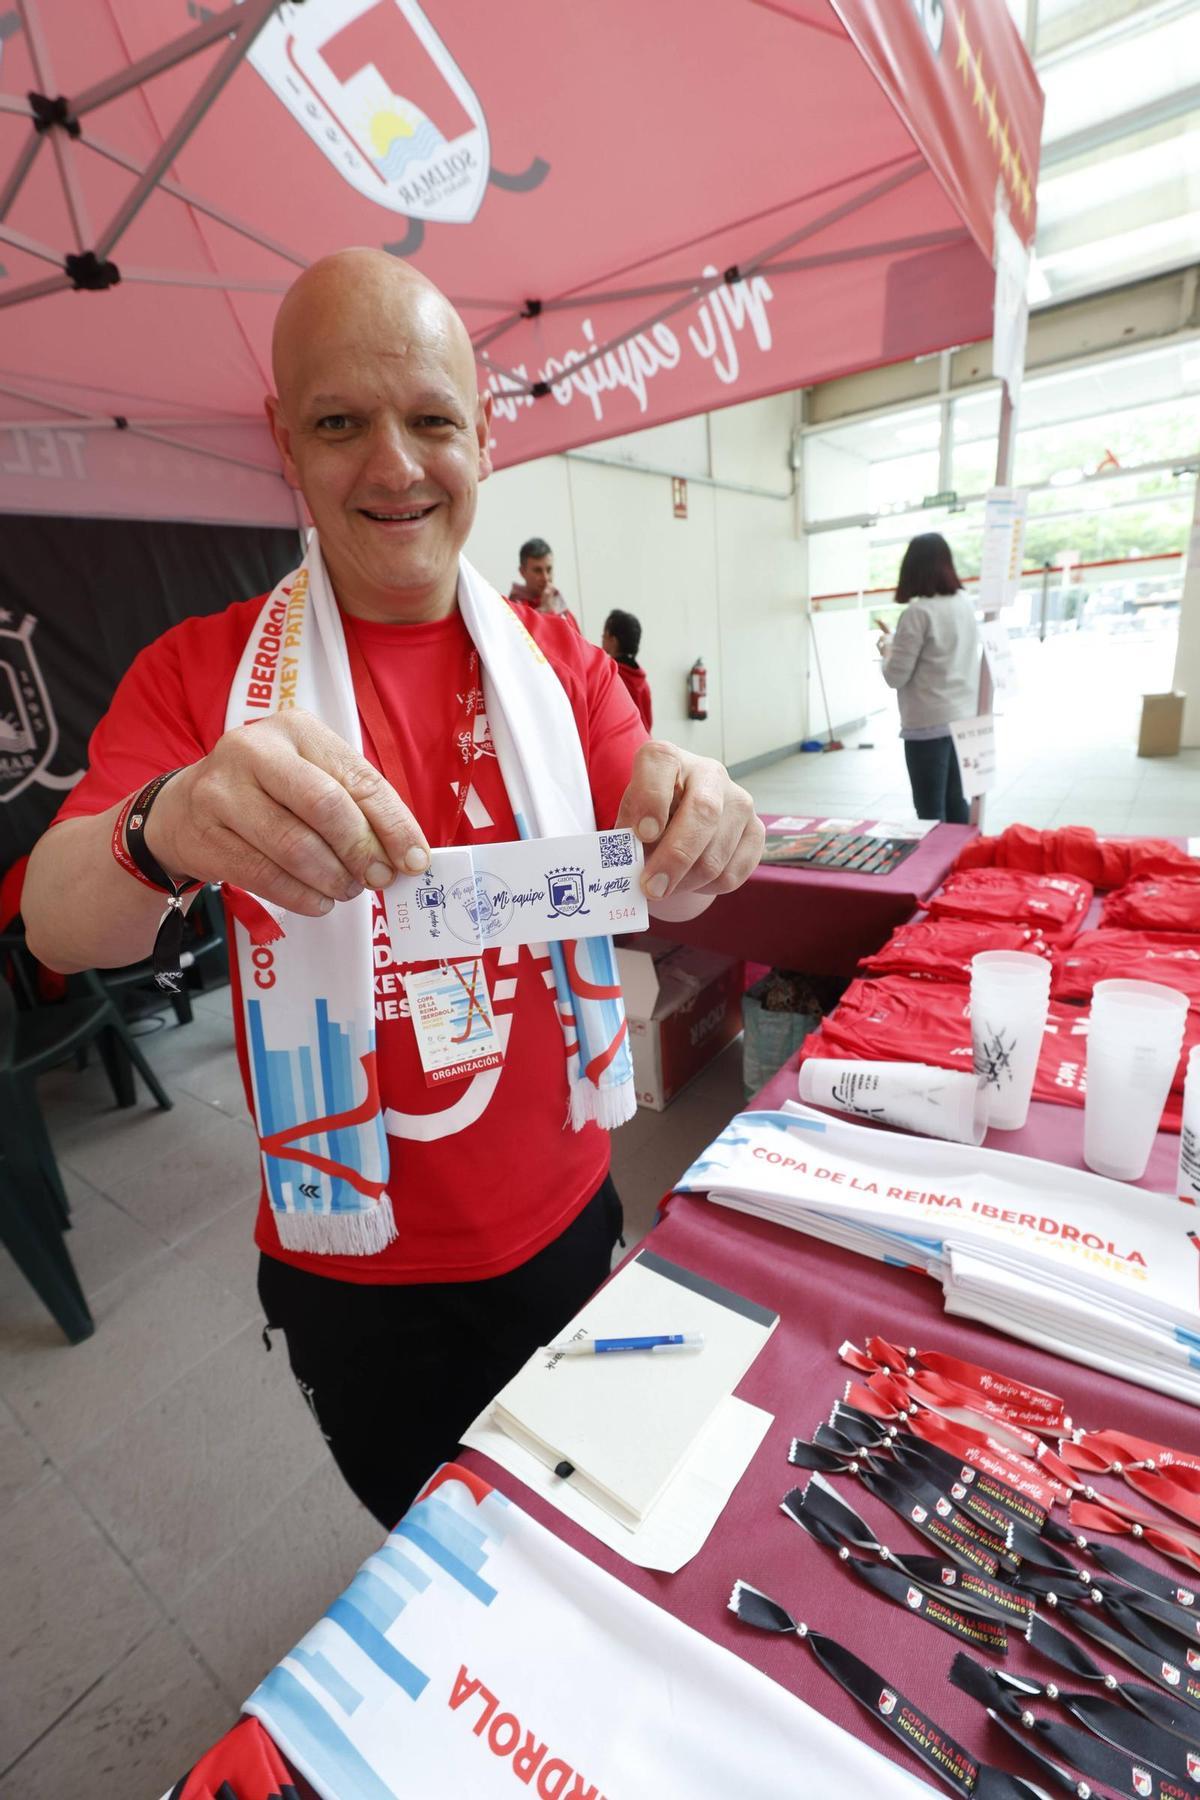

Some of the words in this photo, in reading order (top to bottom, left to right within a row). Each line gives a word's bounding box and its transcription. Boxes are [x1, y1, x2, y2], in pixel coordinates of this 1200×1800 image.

[493, 890, 509, 909] Mi
[511, 888, 545, 909] equipo
[588, 878, 602, 893] mi
[601, 876, 633, 897] gente
[396, 901, 411, 931] 1501
[608, 907, 637, 922] 1544
[432, 1055, 500, 1081] ORGANIZACIÓN
[752, 1147, 807, 1173] COPA
[814, 1167, 846, 1184] DE
[850, 1178, 878, 1193] LA
[886, 1187, 963, 1208] REINA
[971, 1202, 1147, 1267] IBERDROLA
[545, 1328, 588, 1370] Libank
[979, 1455, 1007, 1476] equipo
[1015, 1479, 1044, 1499] gente
[980, 1476, 1000, 1492] COPA
[1001, 1487, 1013, 1498] DE
[1014, 1495, 1025, 1506] LA
[967, 1499, 995, 1521] HOCKEY
[971, 1494, 991, 1512] COPA
[992, 1509, 1004, 1520] DE
[977, 1481, 1005, 1501] HOCKEY
[1005, 1498, 1034, 1519] PATINES
[931, 1518, 952, 1536] COPA
[953, 1534, 964, 1545] DE
[964, 1541, 975, 1552] LA
[951, 1517, 979, 1540] HOCKEY
[979, 1536, 1007, 1555] PATINES
[954, 1513, 976, 1530] COPA
[927, 1523, 954, 1545] HOCKEY
[955, 1543, 983, 1567] PATINES
[961, 1572, 986, 1588] COPA
[987, 1583, 1000, 1595] DE
[1000, 1590, 1011, 1602] LA
[961, 1581, 992, 1599] HOCKEY
[994, 1595, 1026, 1614] PATINES
[925, 1606, 957, 1628] HOCKEY
[958, 1623, 989, 1643] PATINES
[927, 1599, 951, 1617] COPA
[953, 1610, 965, 1622] DE
[977, 1621, 1003, 1636] REINA
[897, 1715, 931, 1749] HOCKEY
[931, 1746, 964, 1780] PATINES
[902, 1707, 926, 1734] COPA
[927, 1729, 941, 1745] DE
[941, 1742, 955, 1758] LA
